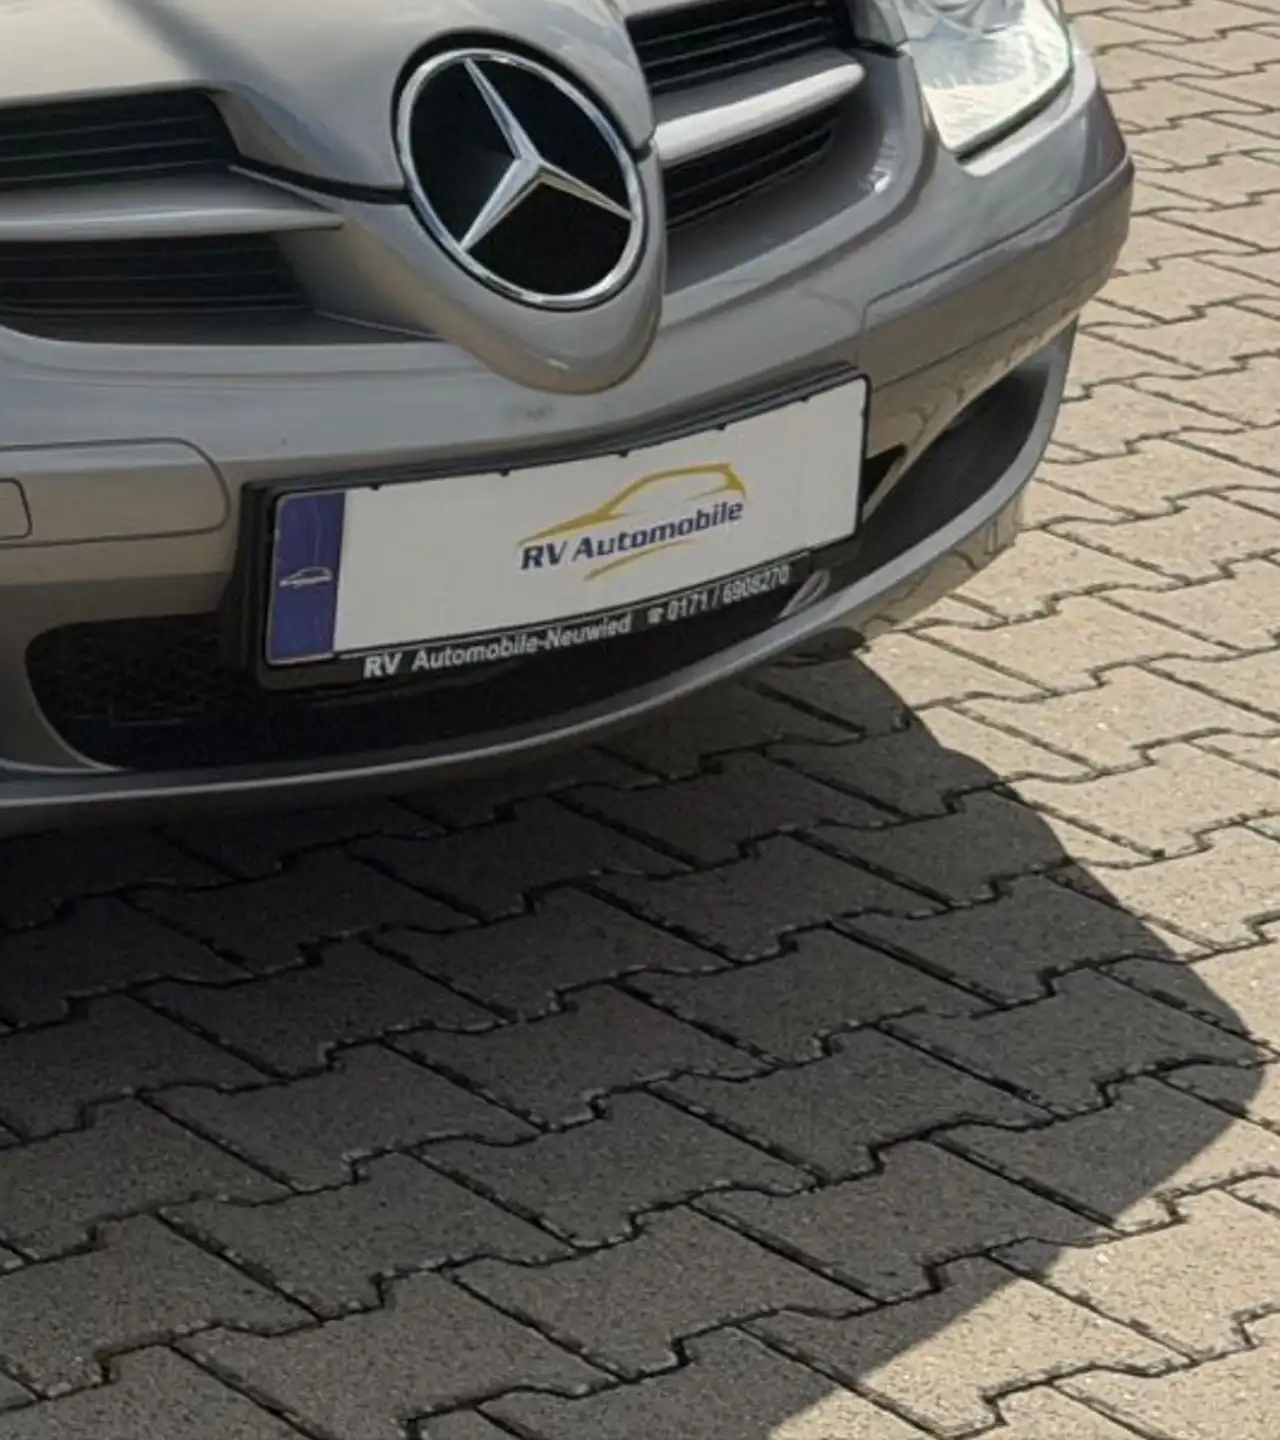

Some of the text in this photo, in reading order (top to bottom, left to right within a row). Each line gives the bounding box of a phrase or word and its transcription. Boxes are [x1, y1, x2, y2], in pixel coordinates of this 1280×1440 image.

[521, 502, 744, 570] RV Automobile
[363, 653, 402, 678] RV
[411, 613, 632, 672] Automobile-Neuwied
[666, 590, 709, 621] 0171
